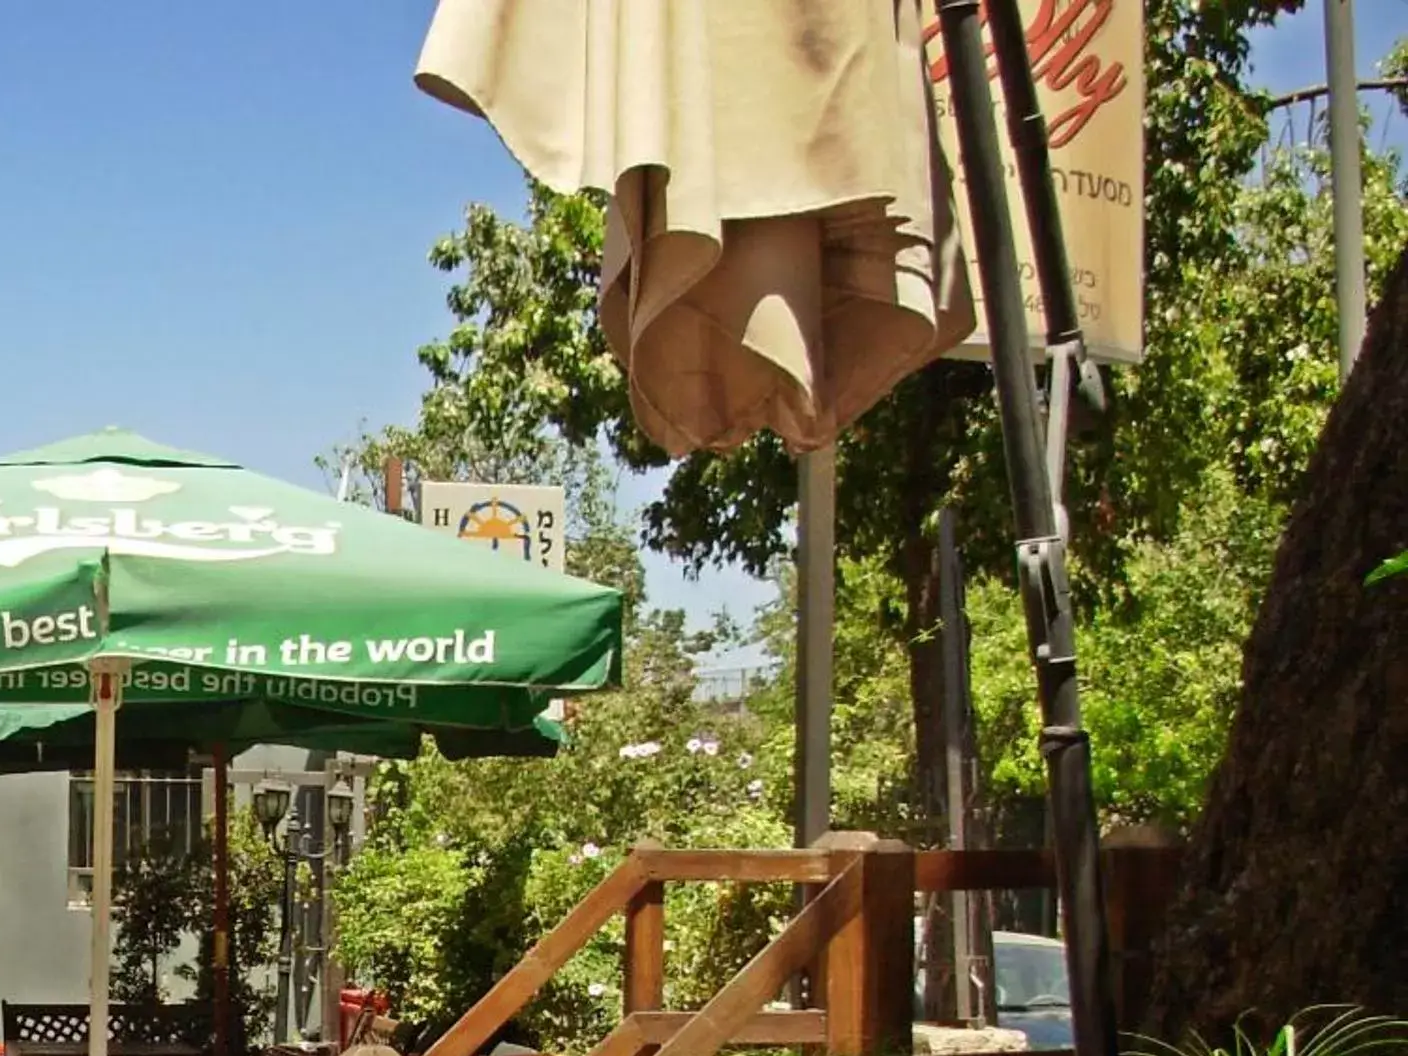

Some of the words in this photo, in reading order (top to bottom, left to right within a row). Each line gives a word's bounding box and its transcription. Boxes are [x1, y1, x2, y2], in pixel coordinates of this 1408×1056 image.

[1, 605, 98, 649] best
[225, 638, 266, 666] in
[281, 637, 352, 665] the
[366, 629, 496, 664] world
